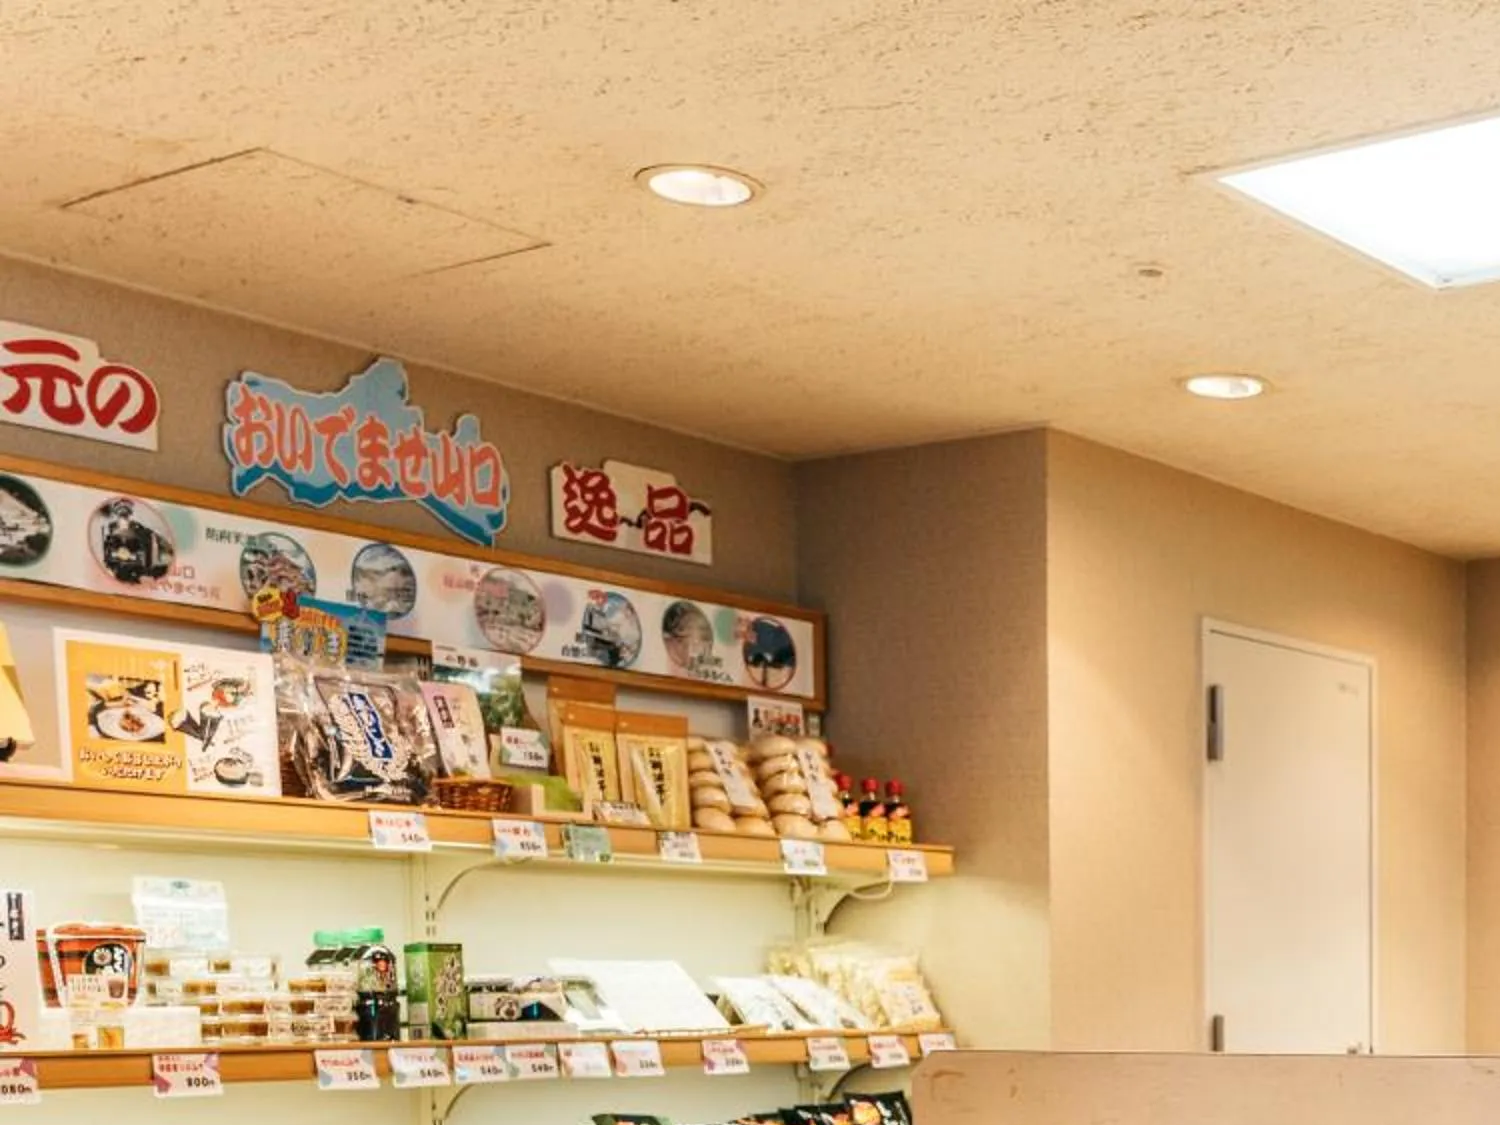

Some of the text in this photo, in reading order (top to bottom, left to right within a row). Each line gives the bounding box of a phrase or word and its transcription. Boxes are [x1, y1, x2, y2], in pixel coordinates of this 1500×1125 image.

[0, 339, 158, 434] 元の
[234, 384, 501, 507] おいでませ山口
[562, 463, 694, 555] 逸品
